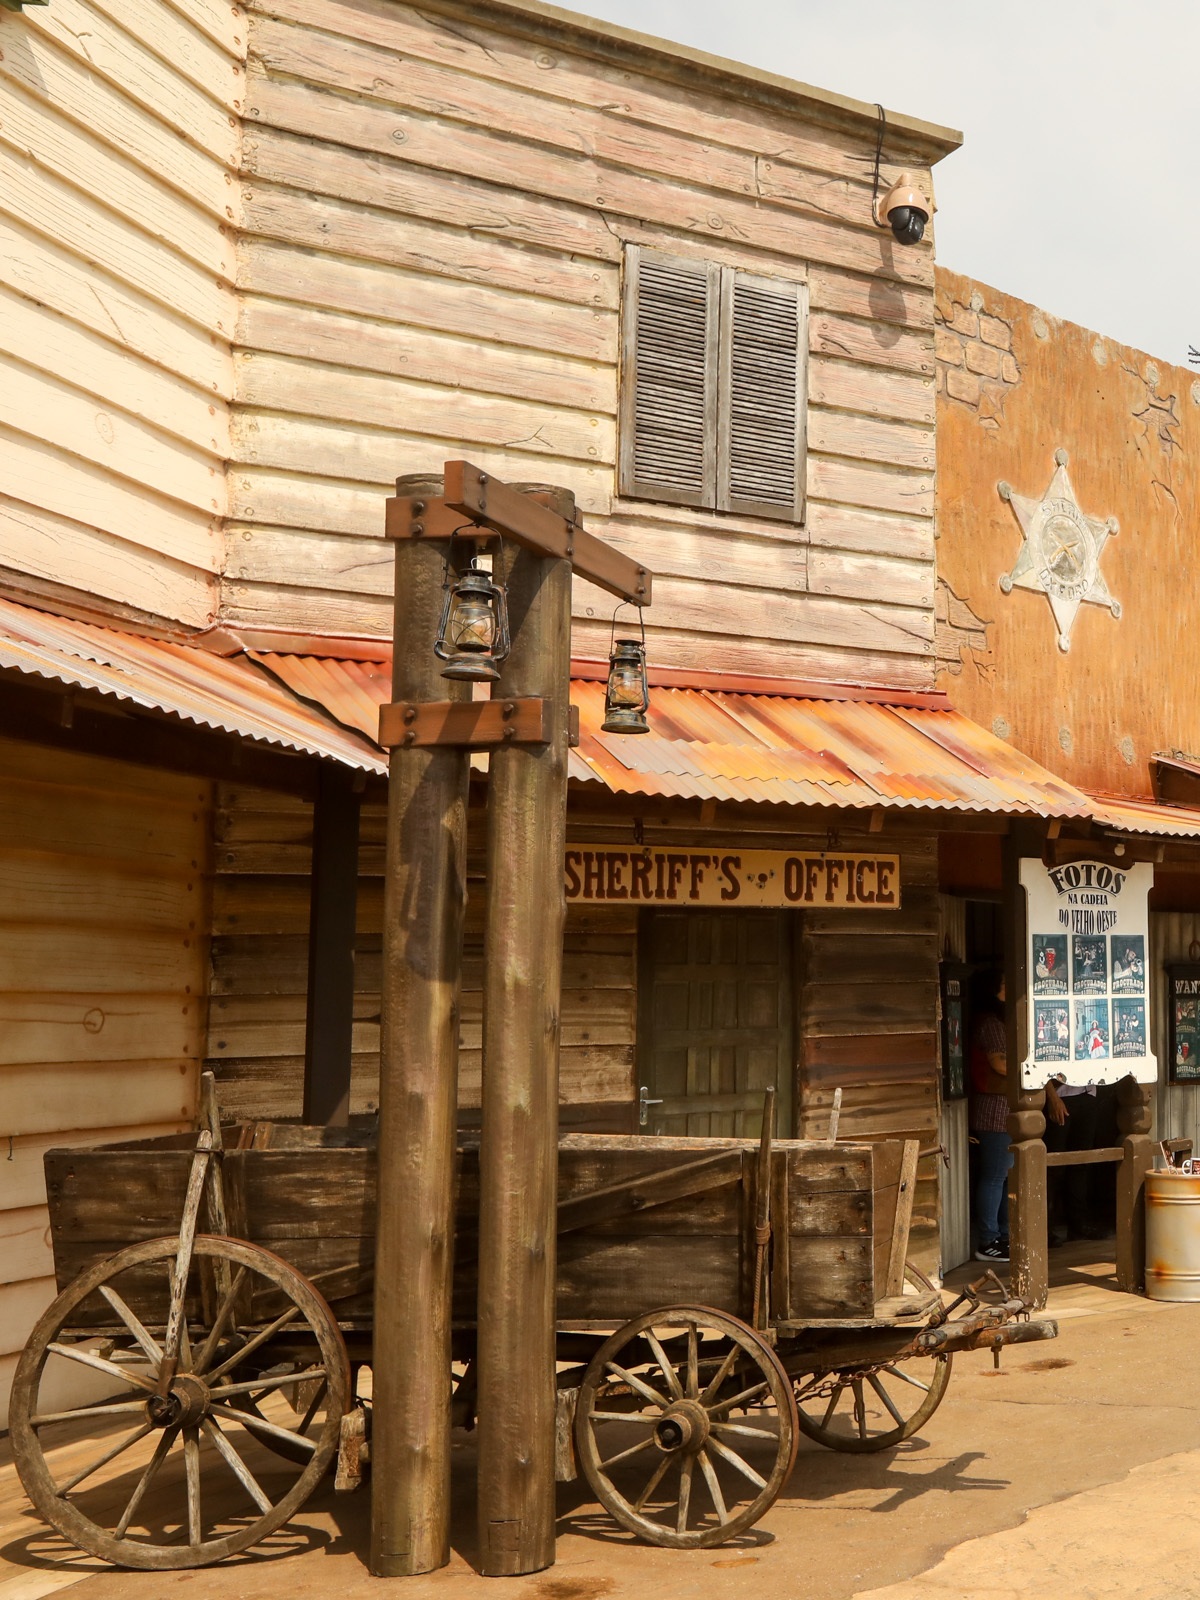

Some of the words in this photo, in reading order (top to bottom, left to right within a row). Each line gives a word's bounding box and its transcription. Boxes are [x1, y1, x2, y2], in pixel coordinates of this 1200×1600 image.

[1039, 568, 1088, 601] OXFORD
[565, 851, 741, 901] SHERIFF'S
[784, 857, 895, 904] OFFICE
[1048, 865, 1126, 894] FOTOS
[1068, 894, 1078, 905] NA
[1080, 894, 1108, 905] CADEIA
[1059, 909, 1069, 927] DO
[1071, 910, 1094, 935] VELHO
[1097, 910, 1118, 934] OESTE
